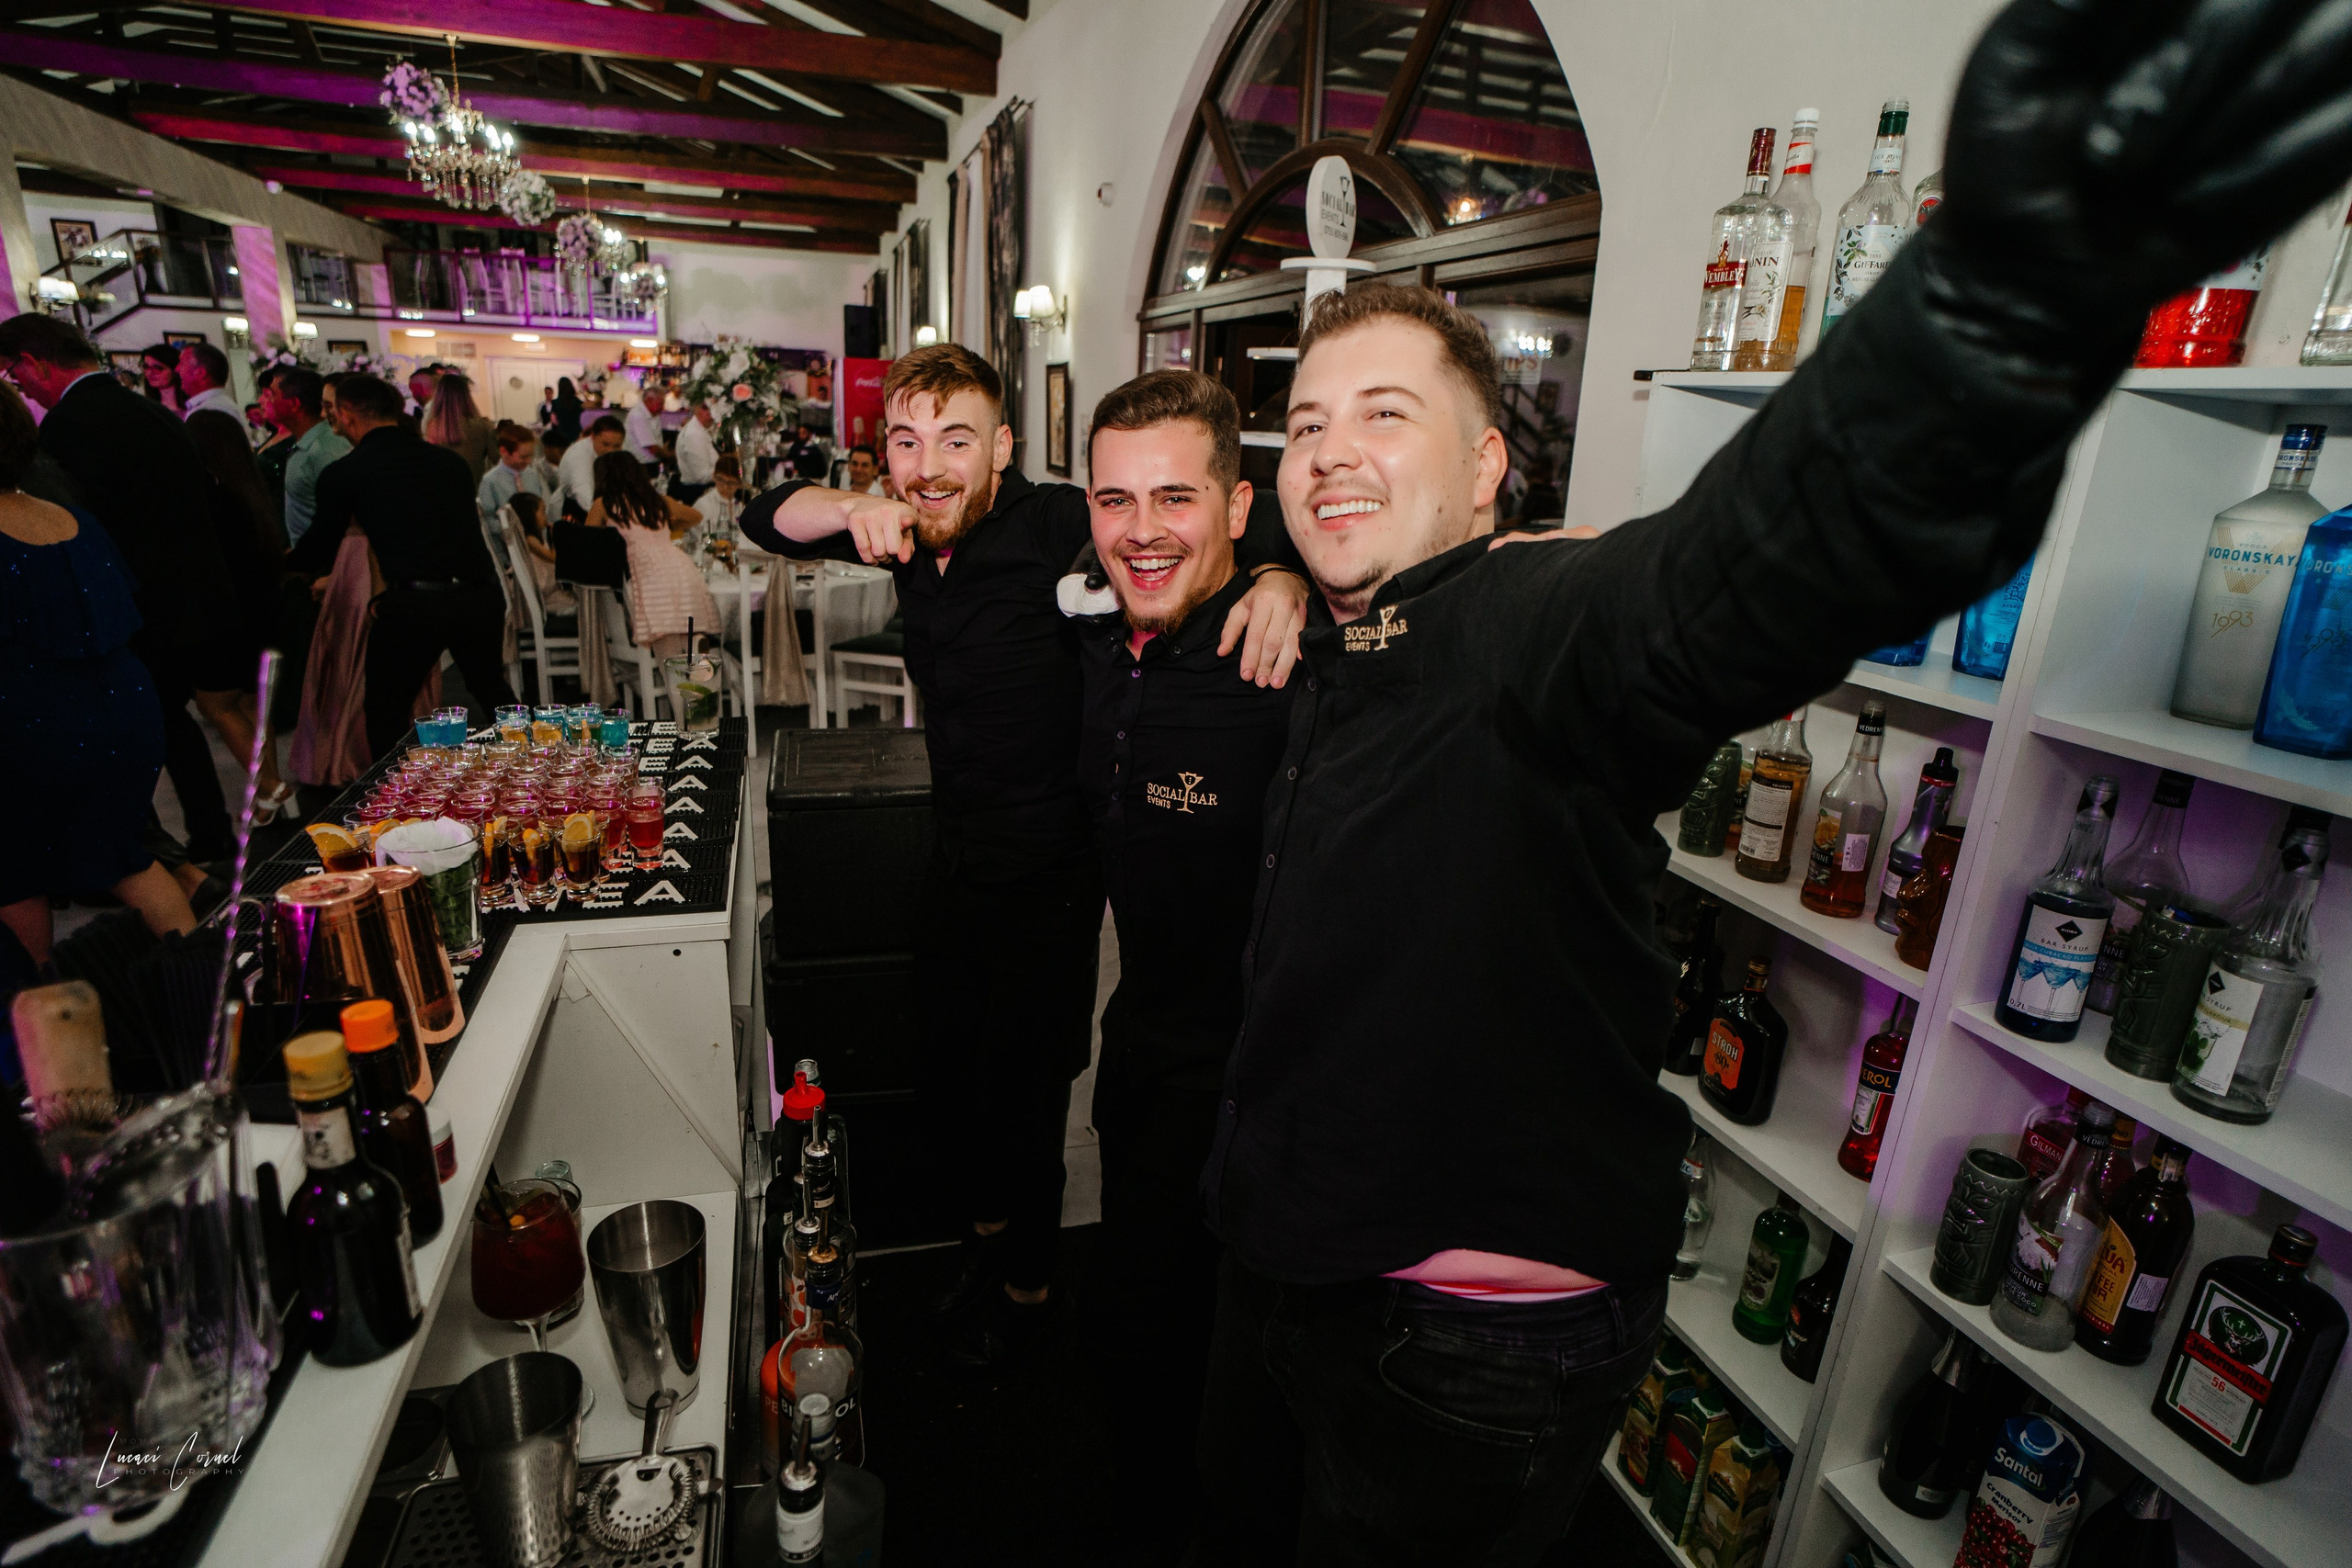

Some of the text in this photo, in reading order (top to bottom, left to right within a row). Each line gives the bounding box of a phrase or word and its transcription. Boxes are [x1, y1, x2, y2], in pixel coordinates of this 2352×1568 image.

[2208, 547, 2299, 567] VORONSKAY
[1344, 619, 1408, 641] SOCIAL BAR
[2211, 610, 2254, 638] 1993
[1346, 641, 1371, 652] EVENTS
[1147, 783, 1218, 807] SOCIAL BAR
[1147, 795, 1170, 809] EVENTS
[2041, 938, 2089, 953] BAR SYRUP
[1712, 1032, 1739, 1061] STROH
[2211, 1376, 2226, 1393] 56
[1994, 1447, 2044, 1488] Santal
[1986, 1482, 2034, 1525] Cranberry
